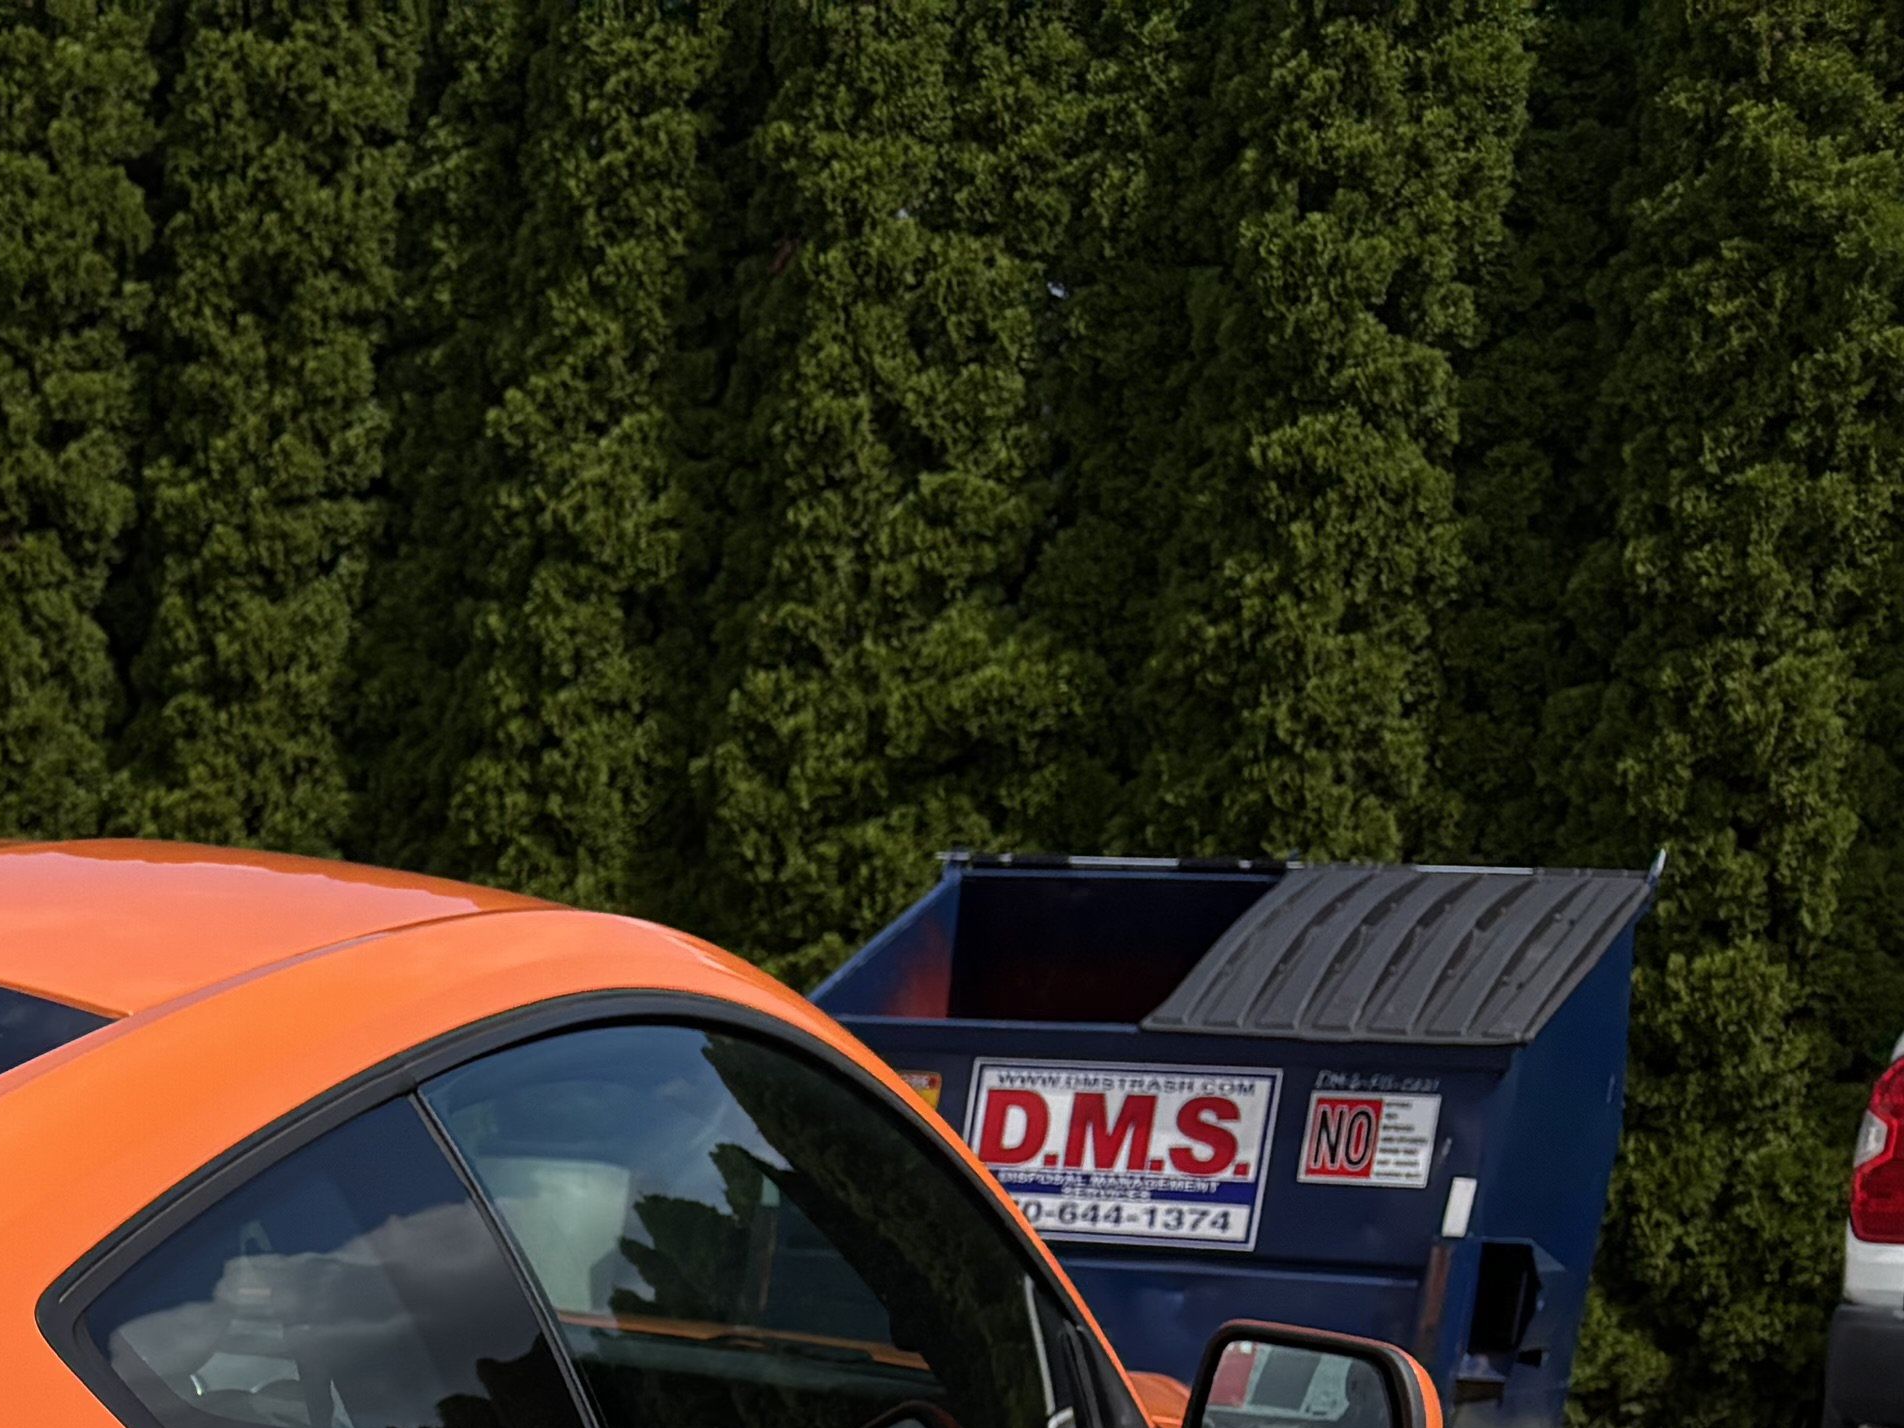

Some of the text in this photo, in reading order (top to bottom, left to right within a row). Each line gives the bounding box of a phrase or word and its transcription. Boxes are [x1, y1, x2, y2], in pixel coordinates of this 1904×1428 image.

[978, 1089, 1250, 1178] D.M.S.
[1311, 1105, 1376, 1172] NO
[1017, 1200, 1231, 1233] 0-644-1374
